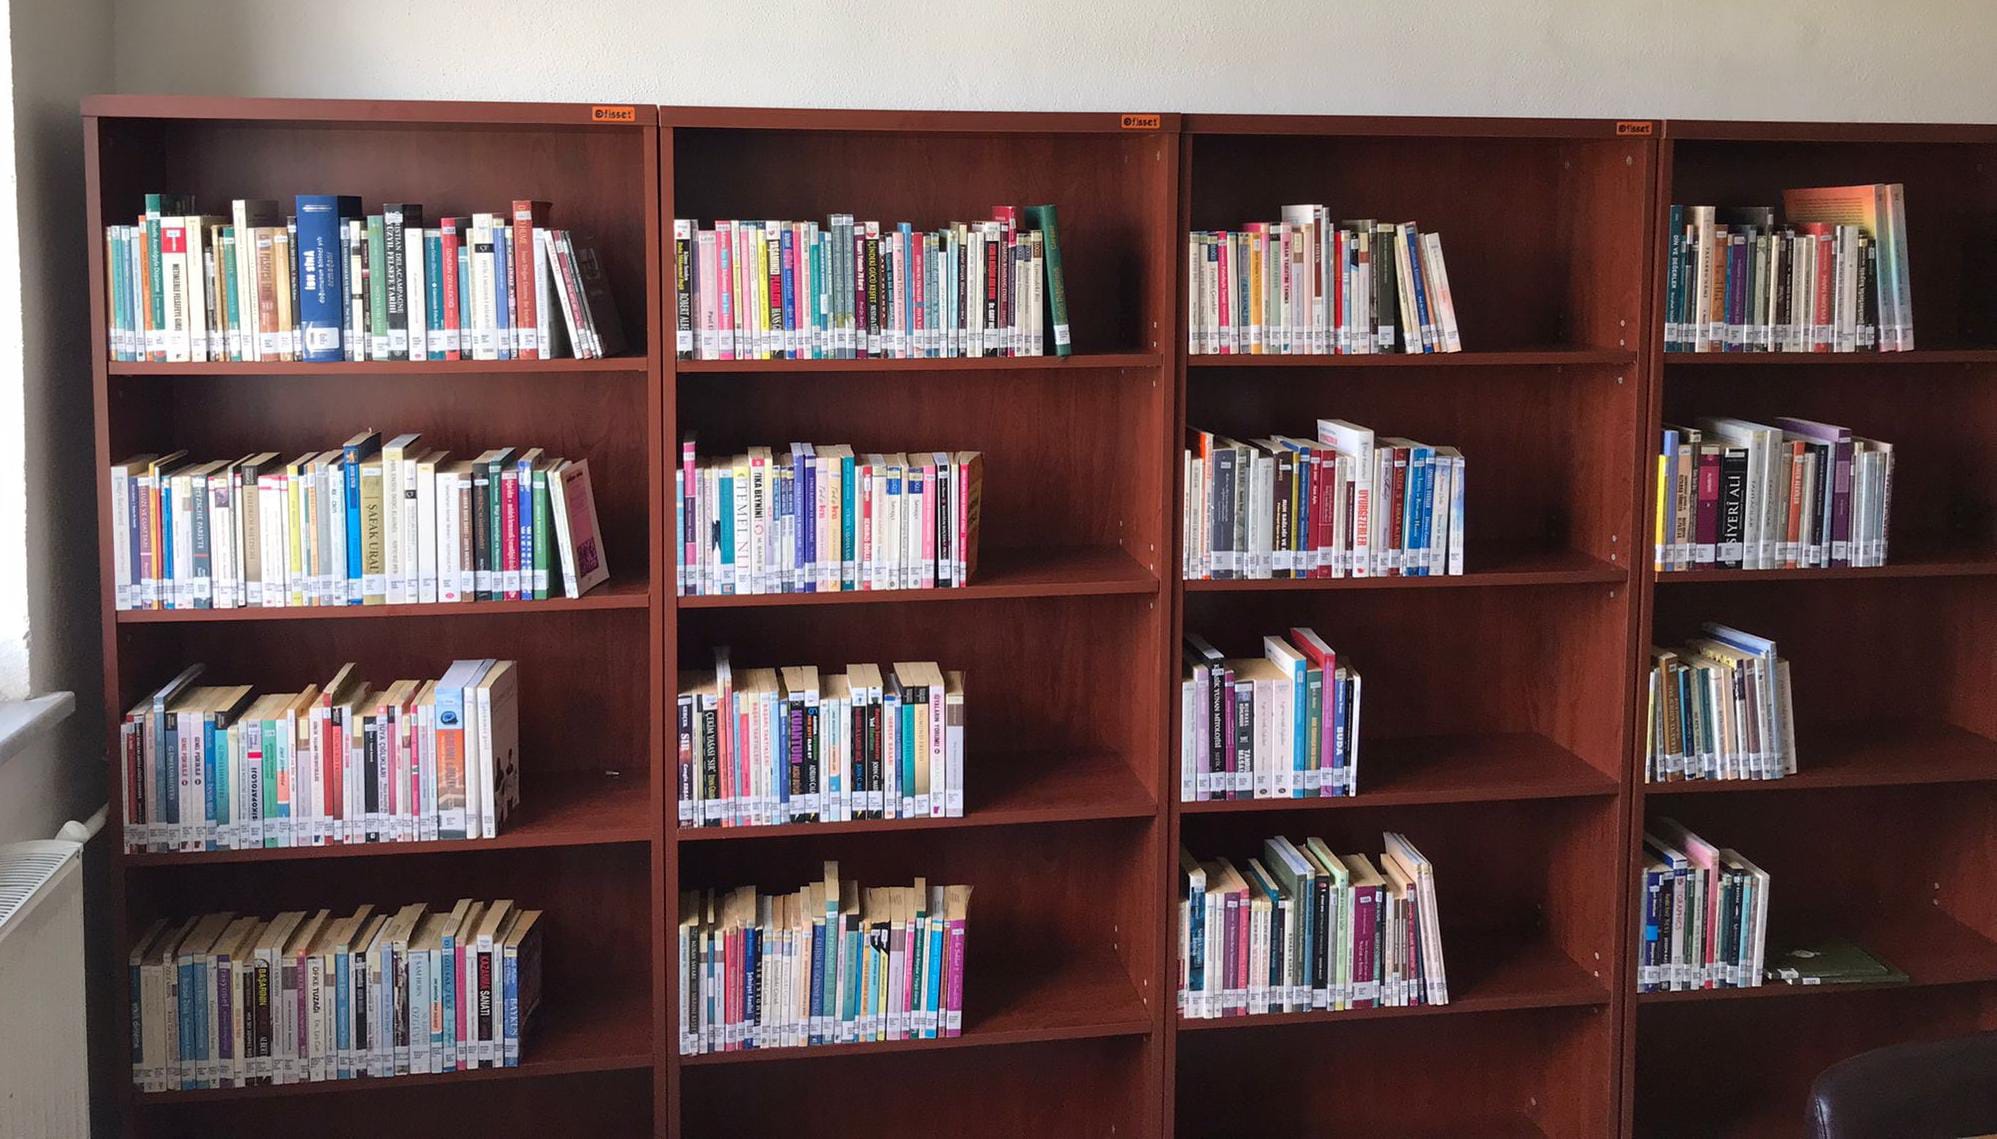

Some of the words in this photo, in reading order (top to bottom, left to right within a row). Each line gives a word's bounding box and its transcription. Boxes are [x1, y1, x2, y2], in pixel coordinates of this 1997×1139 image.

[1672, 246, 1679, 256] VE
[387, 251, 396, 286] FELSEFE
[736, 483, 749, 537] TEMEL
[754, 489, 763, 519] BEYNİNİ
[1358, 489, 1369, 546] UYURGEZERLER
[366, 504, 379, 539] ŞAFAK
[705, 711, 716, 734] ÇEKİM
[808, 707, 818, 715] 6
[680, 732, 690, 751] SIR
[791, 709, 803, 764] KUANTUM
[1213, 713, 1222, 748] MİTOLOJİSİ
[1336, 726, 1344, 756] BUDA
[707, 735, 716, 757] YASASI
[313, 988, 321, 1014] TUZAĞI
[480, 990, 490, 1016] SANATI
